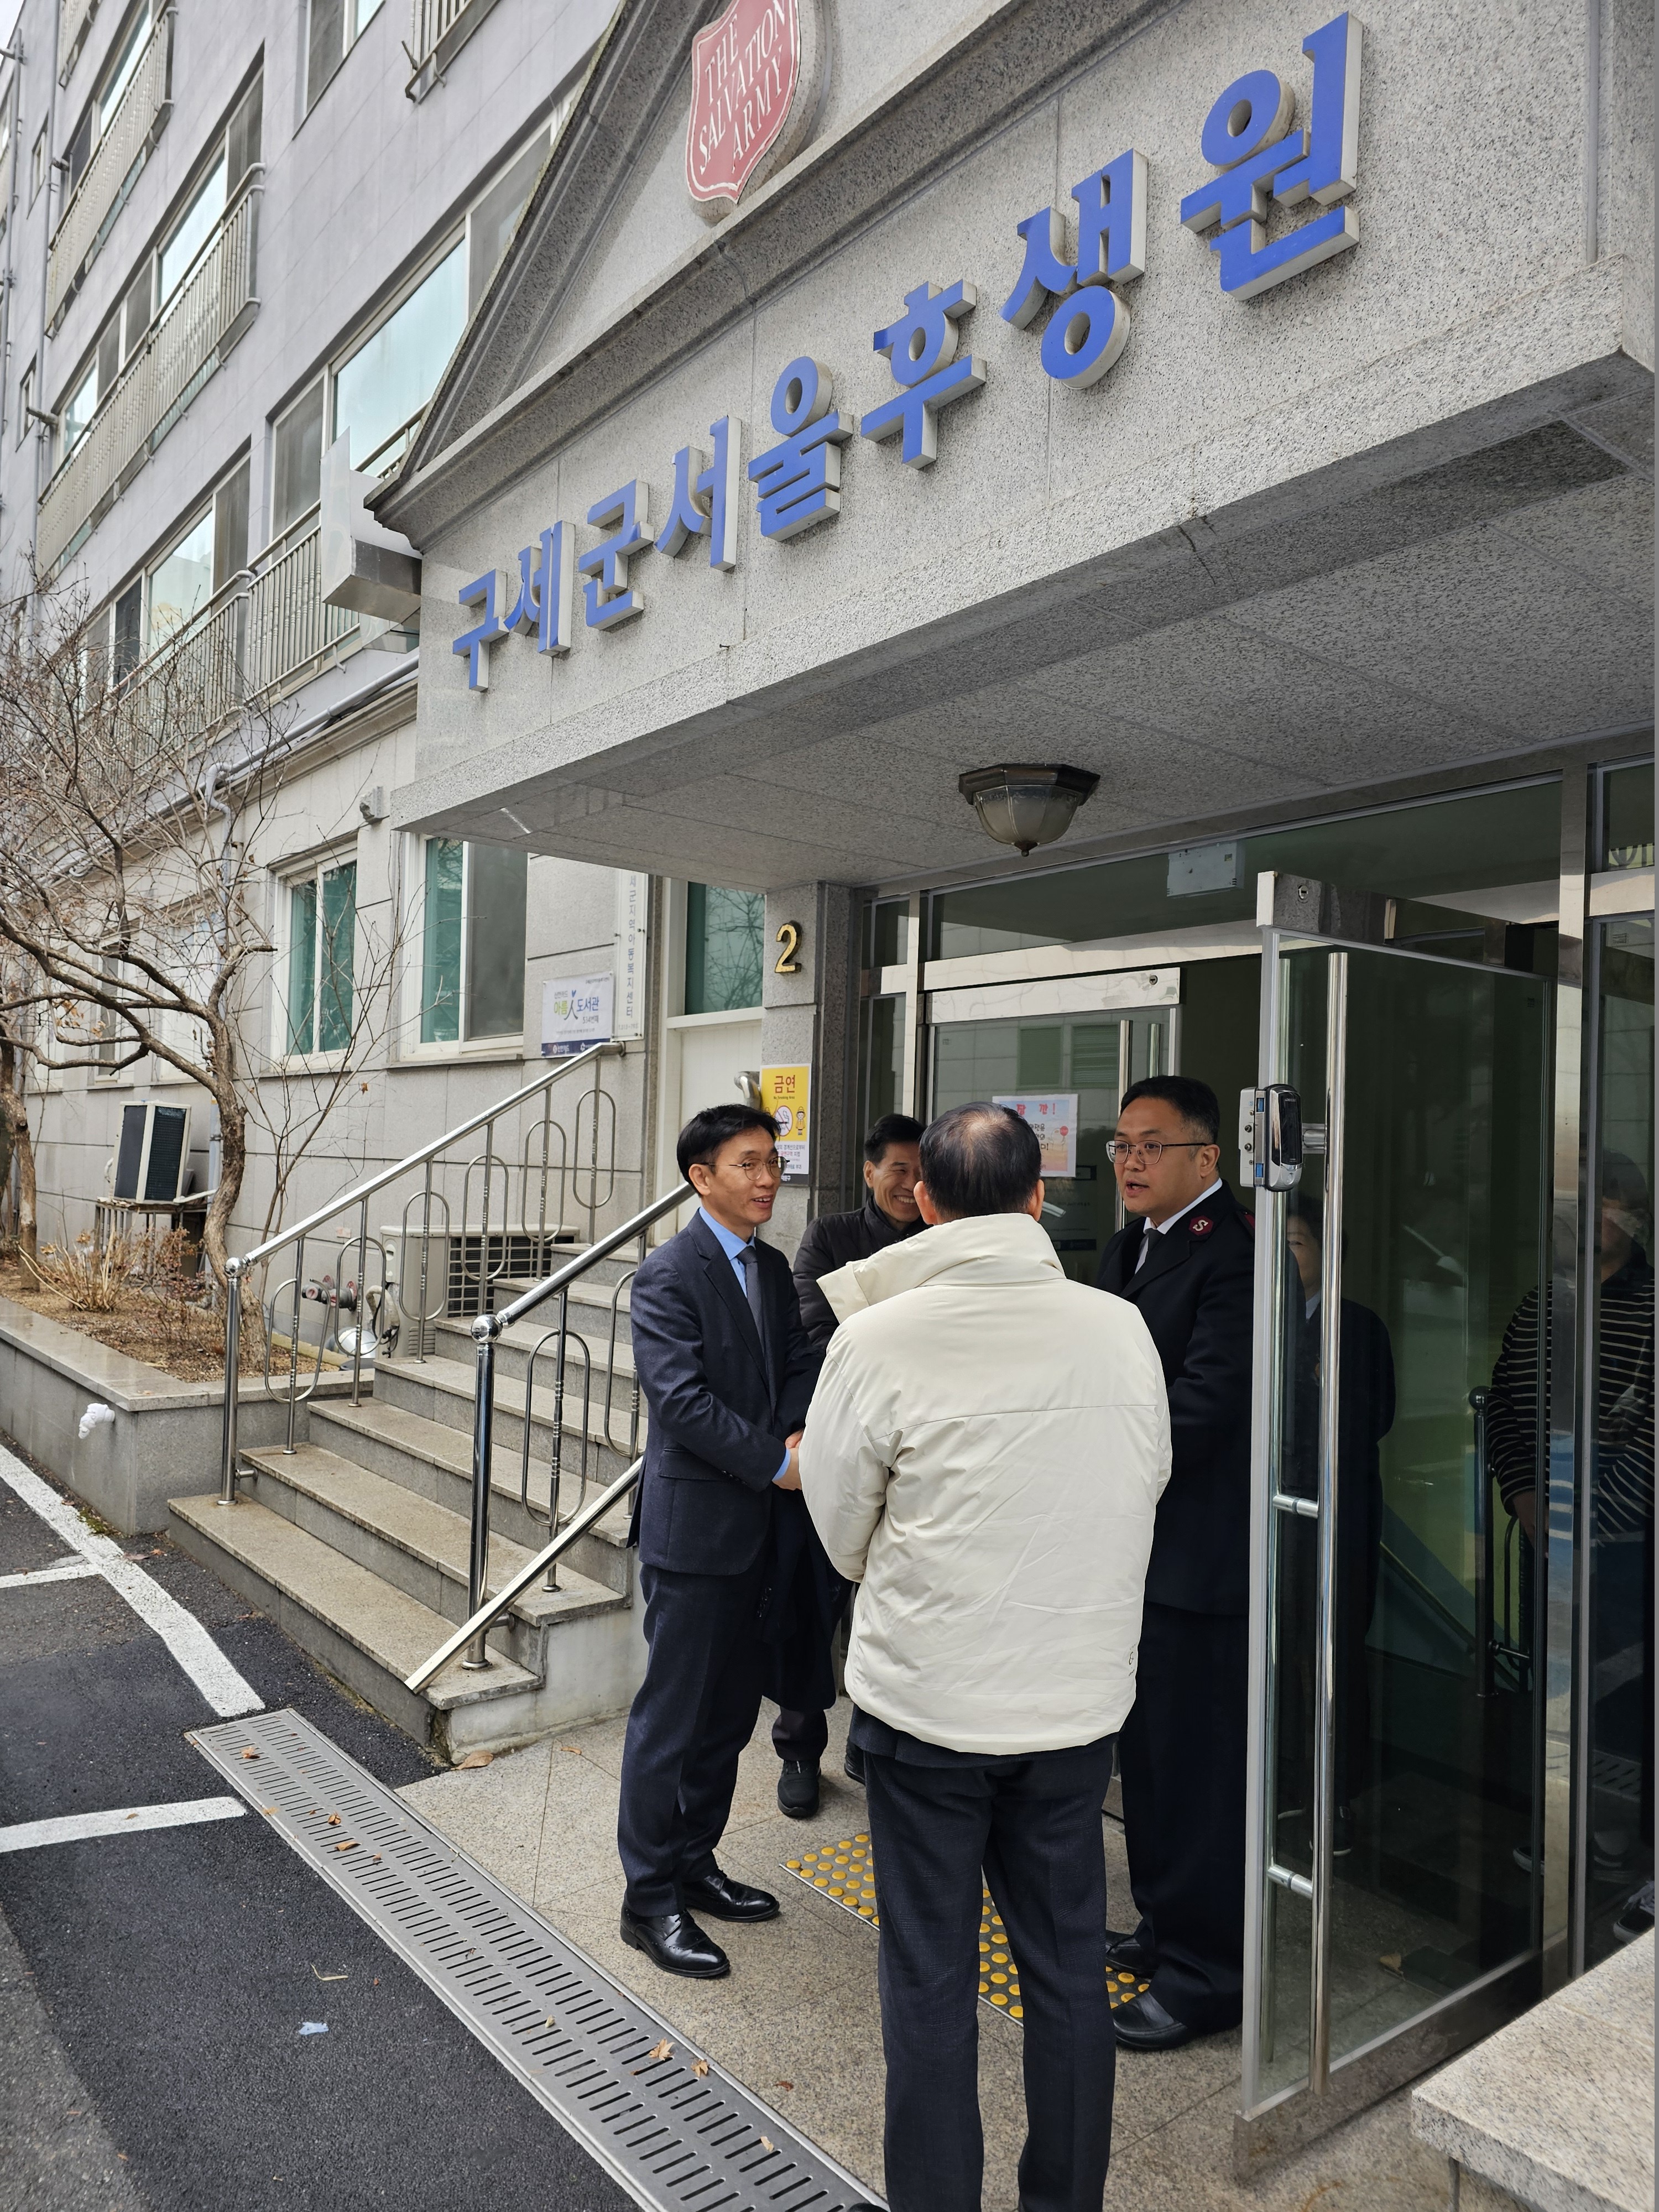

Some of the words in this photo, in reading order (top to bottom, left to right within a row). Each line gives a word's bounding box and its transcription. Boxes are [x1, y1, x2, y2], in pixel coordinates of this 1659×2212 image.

[699, 0, 785, 175] SALVATION
[705, 13, 739, 107] THE
[731, 44, 783, 174] ARMY
[452, 11, 1364, 693] 구세군서울후생원
[775, 922, 800, 974] 2
[774, 1074, 795, 1093] 금연
[1192, 1219, 1209, 1232] S
